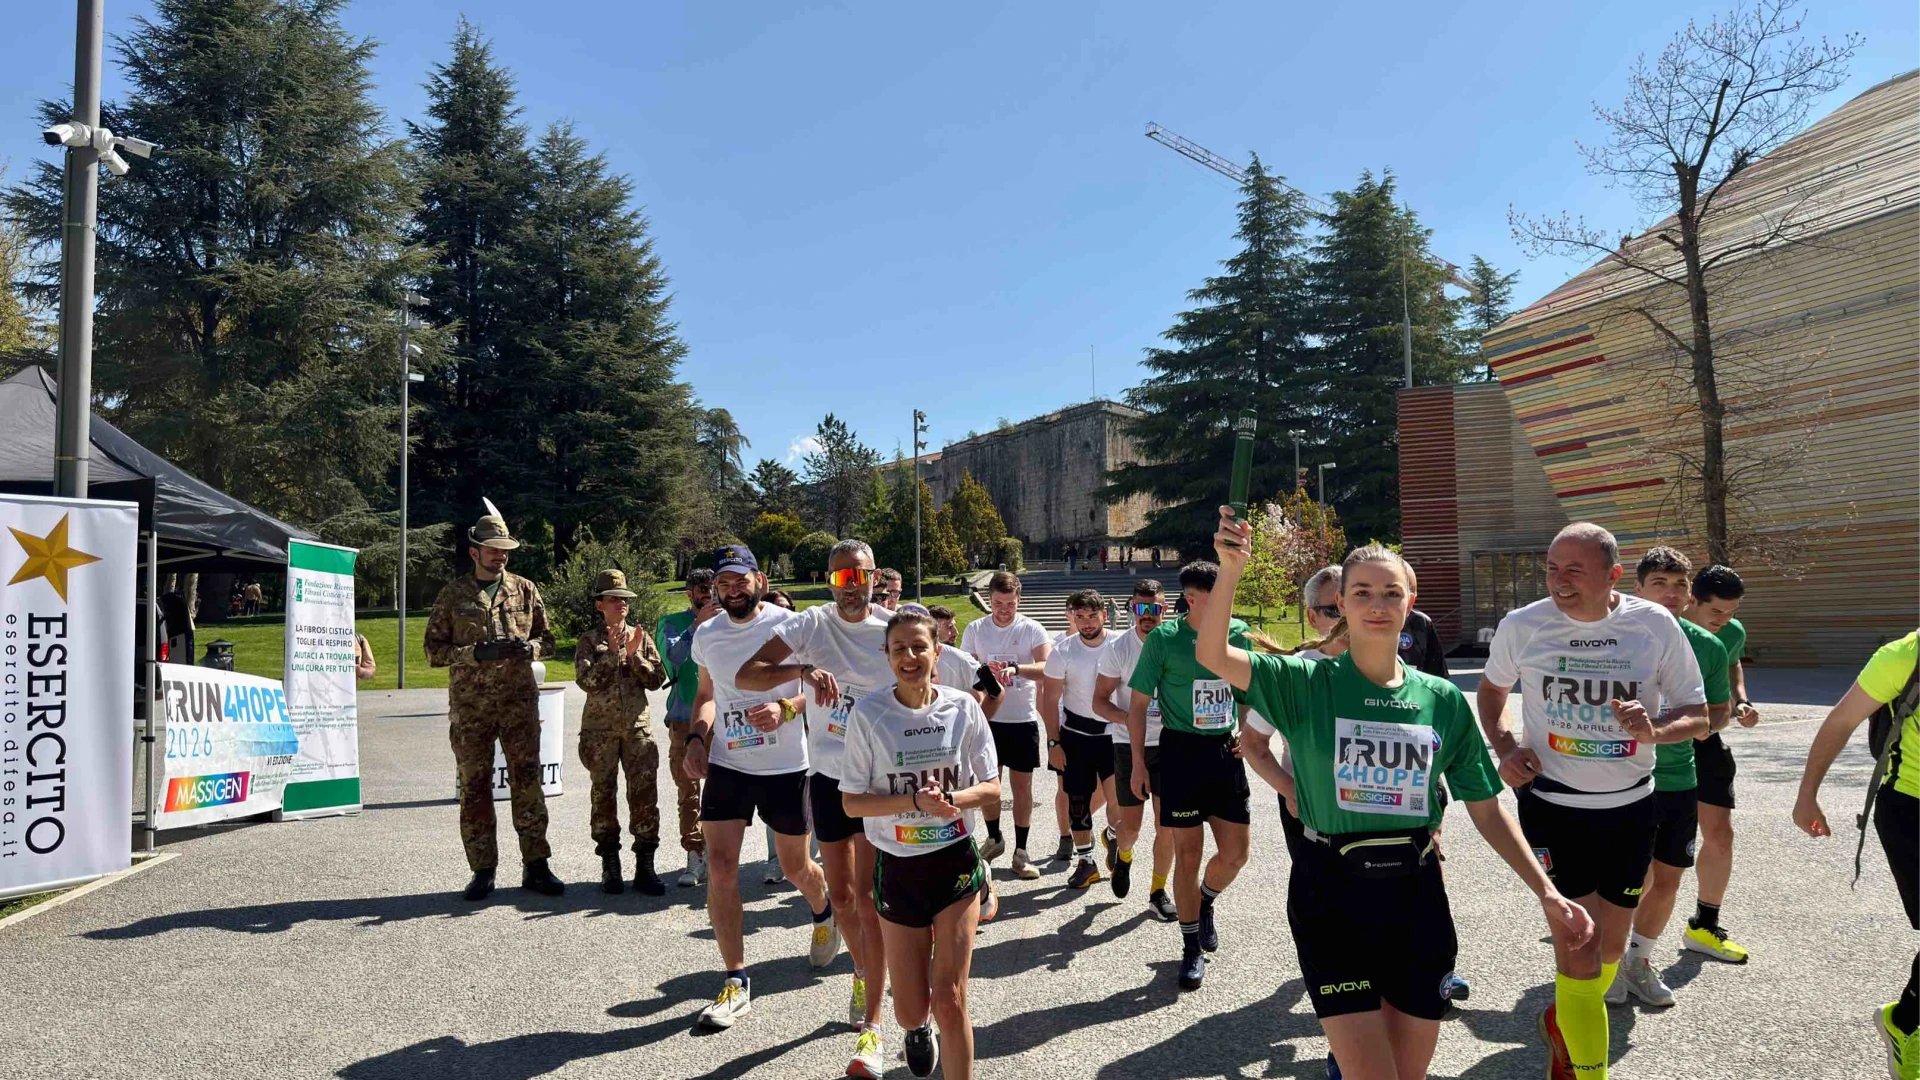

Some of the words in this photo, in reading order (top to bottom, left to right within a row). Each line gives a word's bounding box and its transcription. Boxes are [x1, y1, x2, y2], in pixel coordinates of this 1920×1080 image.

[304, 625, 328, 634] FIBROSI
[329, 627, 353, 635] CISTICA
[296, 637, 316, 646] TOGLIE
[318, 638, 324, 646] IL
[326, 639, 352, 648] RESPIRO
[1570, 639, 1618, 647] GIVOVA
[294, 651, 317, 660] AIUTACI
[320, 652, 324, 660] A
[326, 652, 354, 661] TROVARE
[291, 663, 304, 671] UNA
[305, 664, 324, 672] CURA
[338, 665, 354, 673] TUTT
[1365, 698, 1421, 710] GIVOVA
[1546, 702, 1615, 723] 4HOP
[25, 612, 68, 855] ESERCITO
[904, 725, 946, 737] GIVOVA
[1577, 724, 1614, 732] APRILE
[3, 614, 19, 858] esercito.difesa.it
[167, 727, 213, 758] 2026
[1555, 738, 1631, 755] MASSIGEN
[1338, 765, 1427, 787] 4HOPE
[175, 776, 242, 806] MASSIGEN
[1345, 791, 1397, 803] MASSIGEN
[901, 823, 961, 840] MASSIGEN
[1320, 980, 1371, 995] GIVOVA
[1574, 1061, 1604, 1071] VOVA
